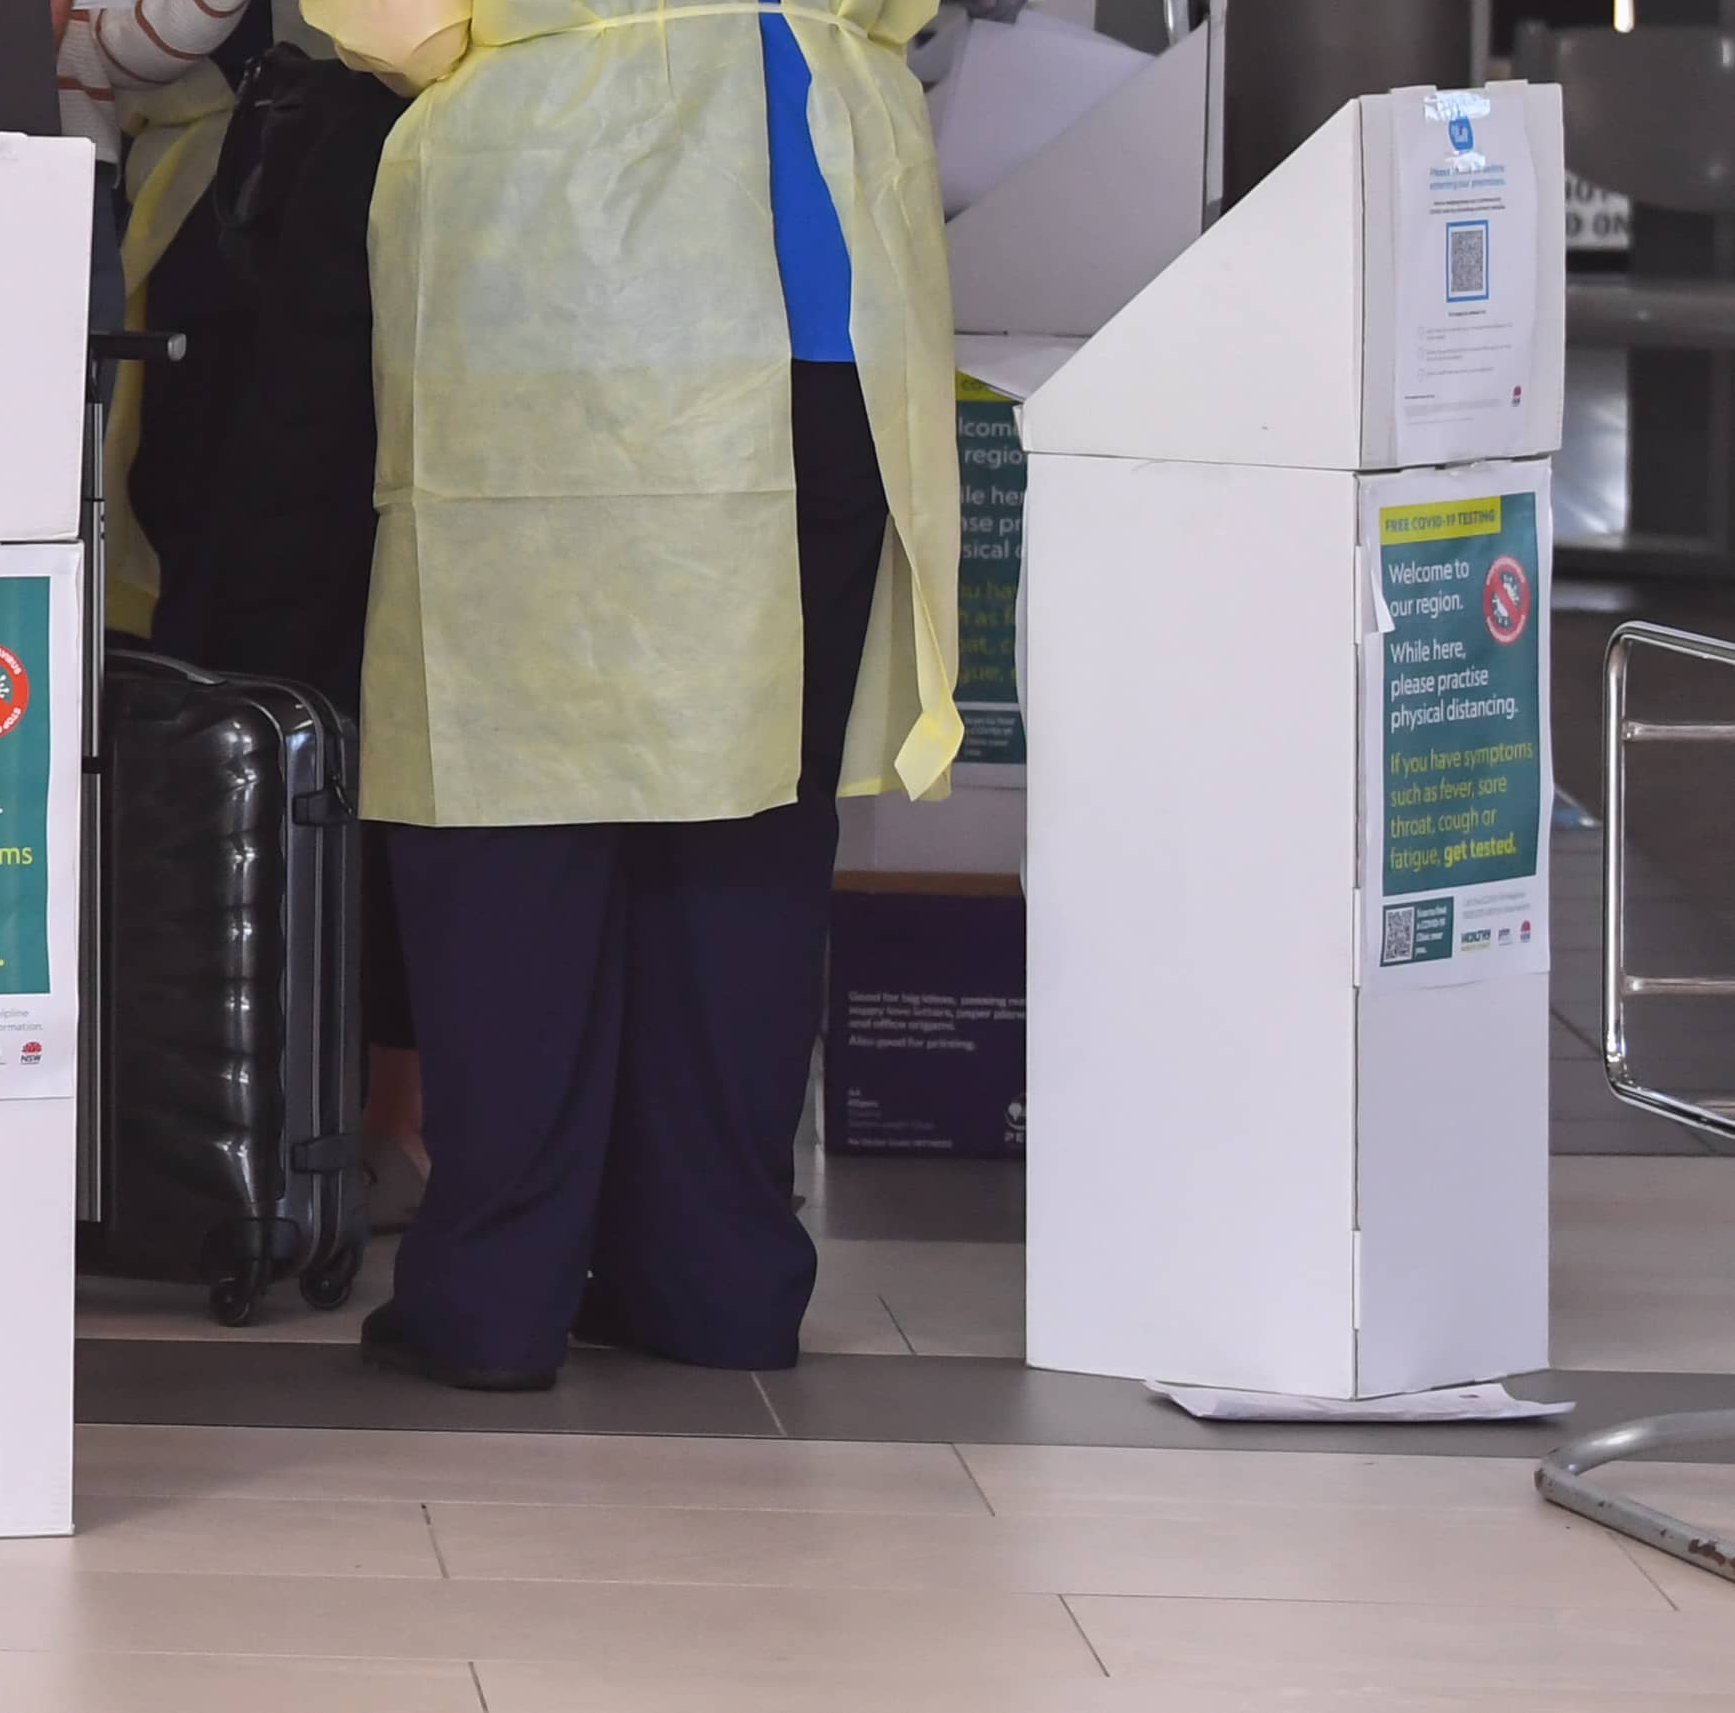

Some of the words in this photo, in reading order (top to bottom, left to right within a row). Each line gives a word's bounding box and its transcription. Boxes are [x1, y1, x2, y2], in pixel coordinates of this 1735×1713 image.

[958, 416, 1015, 437] lcom
[964, 446, 1023, 469] regio
[991, 484, 1025, 505] her
[1385, 517, 1410, 533] FREE
[1412, 514, 1456, 531] COVID-19
[1458, 509, 1495, 526] TESTING
[962, 539, 1009, 560] sical
[1388, 561, 1452, 585] Welcome
[1454, 558, 1470, 579] to
[1389, 599, 1413, 618] our
[1415, 590, 1464, 620] region.
[1390, 638, 1430, 665] While
[1433, 638, 1467, 660] here,
[1390, 673, 1435, 703] please
[1437, 665, 1489, 696] practise
[1390, 702, 1444, 734] physical
[1446, 695, 1520, 721] distancing.
[1391, 753, 1402, 776] If
[1402, 756, 1428, 779] you
[1430, 748, 1461, 769] have
[1463, 741, 1534, 768] symptoms
[1390, 786, 1421, 808] such
[1424, 786, 1438, 803] as
[1439, 777, 1475, 800] fever,
[1478, 776, 1508, 796] sore
[1390, 815, 1435, 839] throat,
[1438, 808, 1480, 833] cough
[1481, 807, 1498, 827] or
[1390, 846, 1441, 873] fatigue,
[1444, 841, 1468, 868] get
[1470, 832, 1518, 860] tested.
[20, 1054, 41, 1065] NSW
